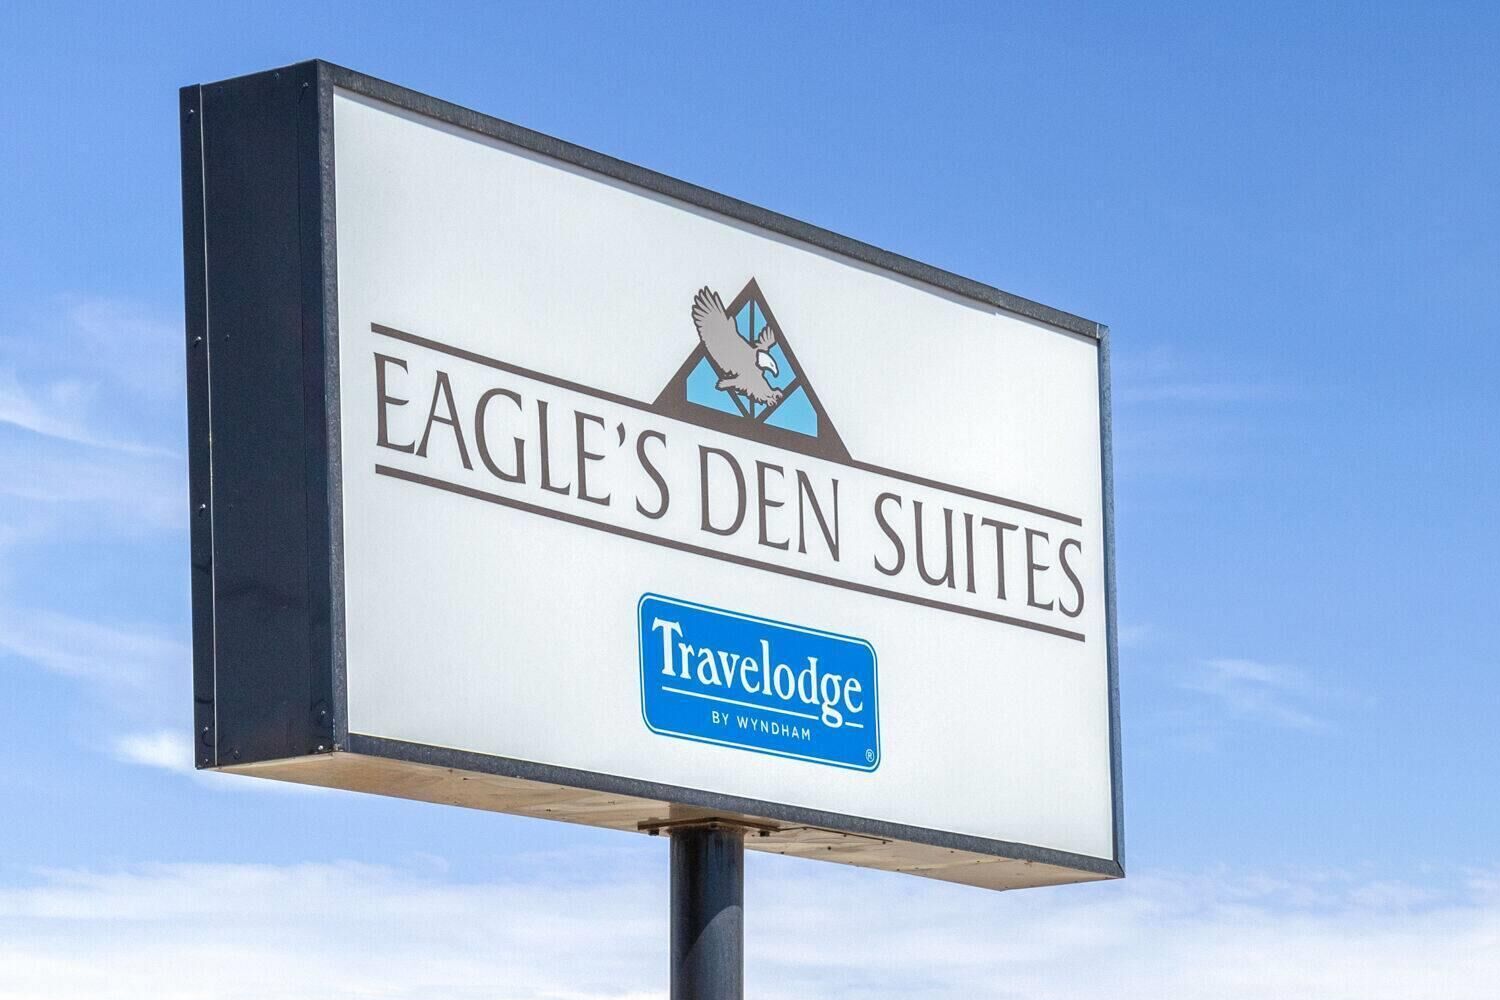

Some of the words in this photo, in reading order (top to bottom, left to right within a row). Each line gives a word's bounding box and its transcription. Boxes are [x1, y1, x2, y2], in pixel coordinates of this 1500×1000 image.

[373, 351, 670, 520] EAGLE'S
[697, 444, 840, 562] DEN
[873, 492, 1085, 618] SUITES
[651, 616, 864, 729] Travelodge
[711, 710, 729, 726] BY
[736, 715, 811, 741] WYNDHAM
